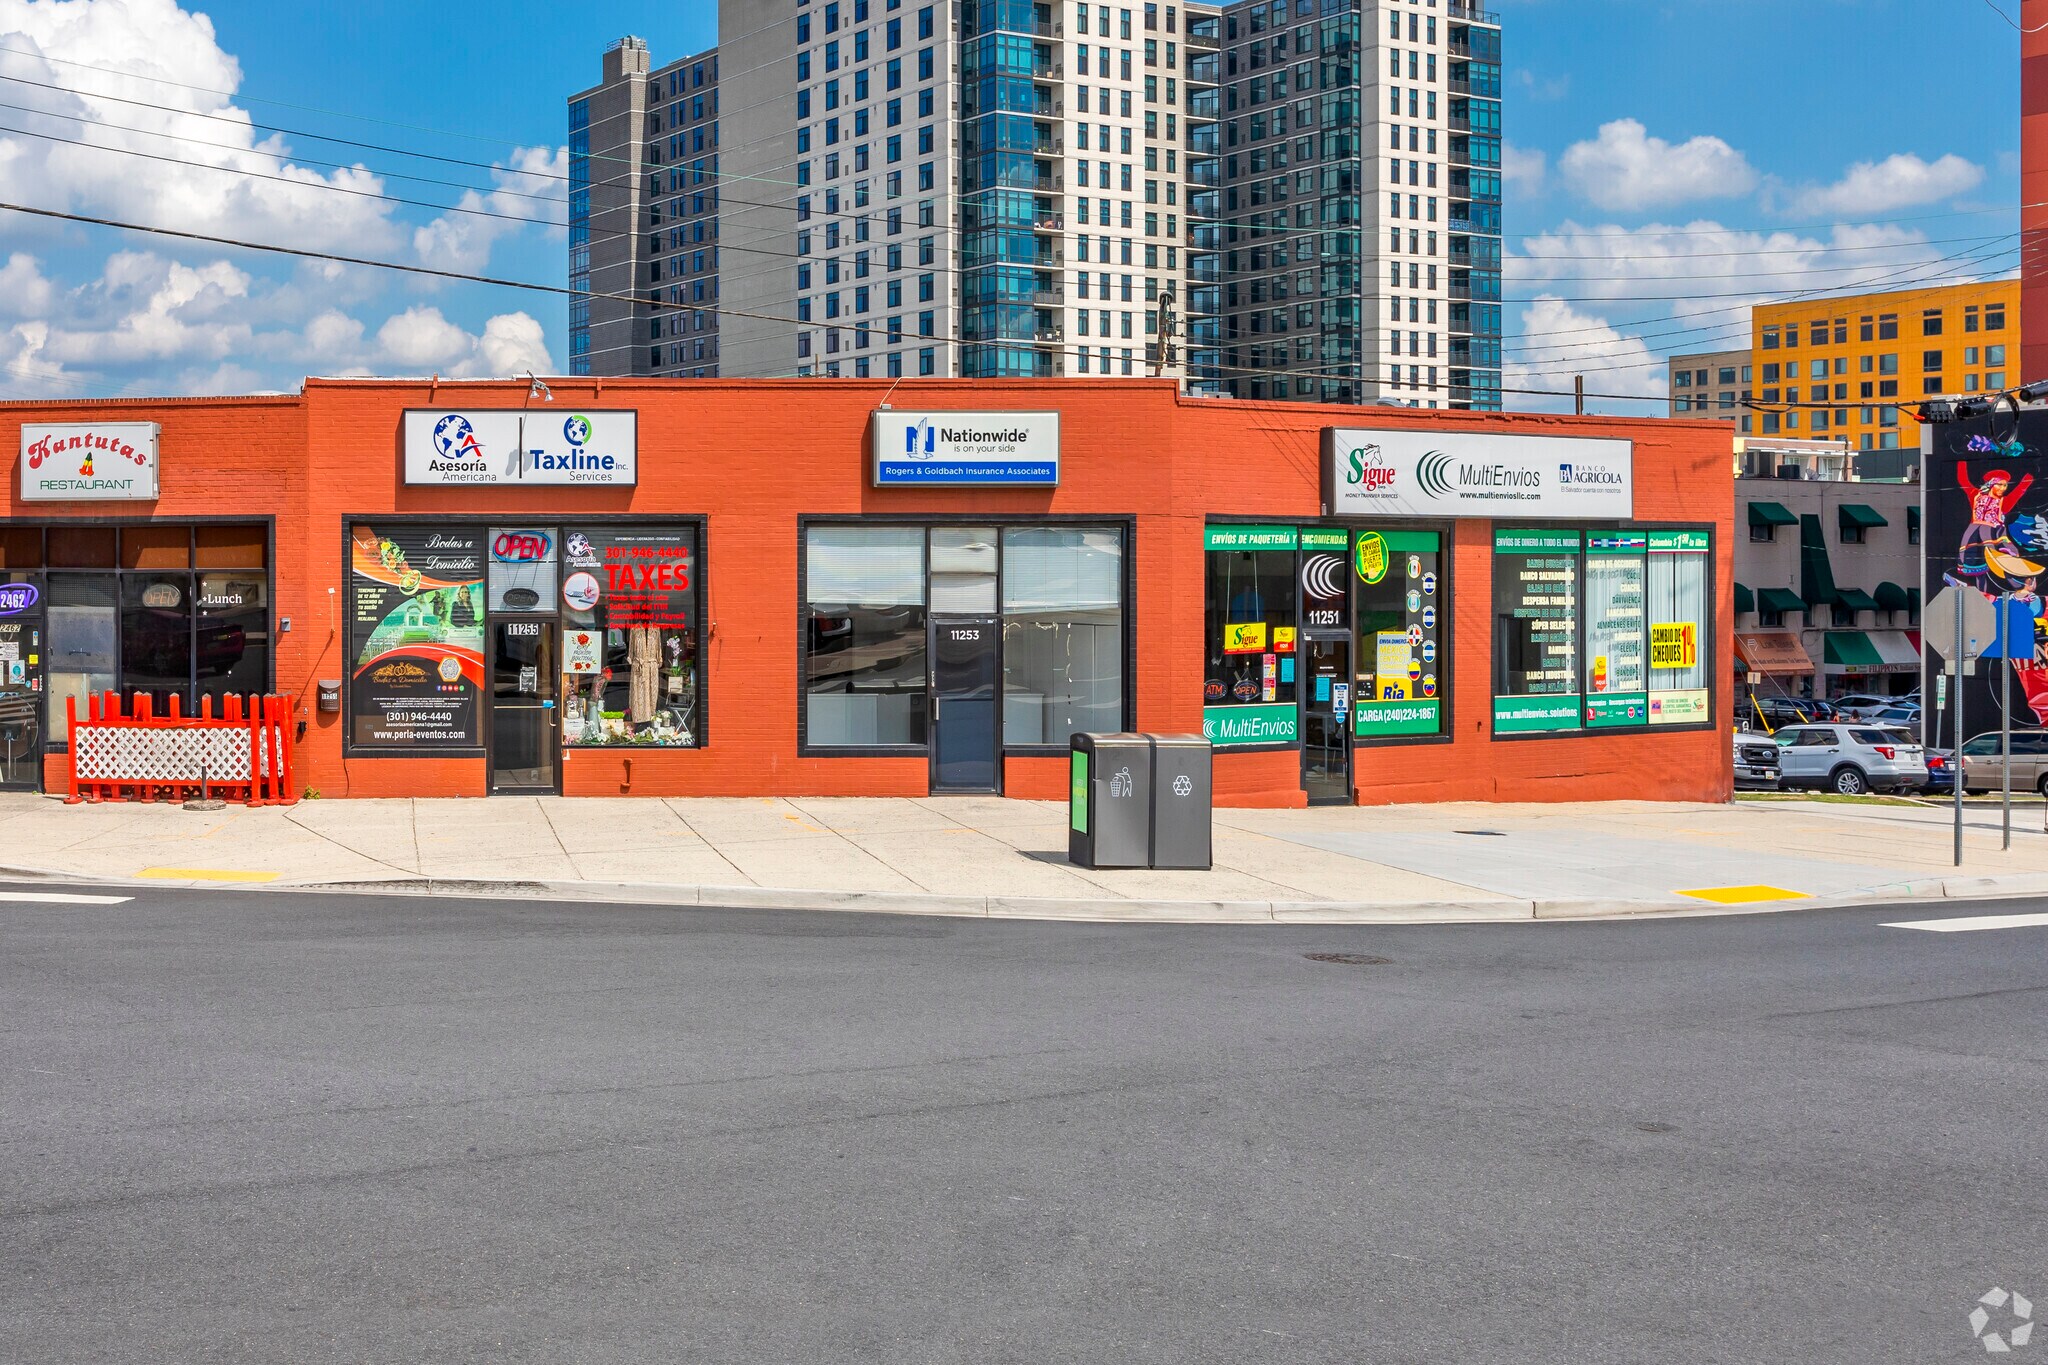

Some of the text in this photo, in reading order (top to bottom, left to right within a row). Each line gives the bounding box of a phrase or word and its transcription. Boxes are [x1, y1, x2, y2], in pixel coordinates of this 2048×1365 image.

[941, 428, 1027, 442] Nationwide
[27, 432, 147, 470] Kantutas
[954, 444, 960, 452] is
[976, 446, 996, 454] your
[998, 444, 1015, 452] side
[530, 449, 628, 470] Taxline Inc.
[429, 459, 487, 472] Asesoría
[1347, 448, 1396, 491] Sigue
[442, 472, 497, 481] Americana
[569, 471, 612, 481] Services
[886, 467, 1050, 476] Rogers & Goldbach Insurance Associates
[1459, 464, 1540, 487] MultiEnvios
[1574, 472, 1622, 483] AGRICOLA
[40, 478, 134, 490] RESTAURANT
[1459, 492, 1541, 500] www.multienviosllc.com
[425, 534, 462, 548] Bodas
[1212, 532, 1347, 544] ENVÍOS DE PAQUETERÍA Y ENCOMIENDAS
[1496, 536, 1579, 547] ENVÍOS DE DINERO A TODO EL MUNDO
[1650, 538, 1672, 547] Colombia
[495, 534, 547, 559] OPEN
[605, 547, 688, 558] 301-946-4440
[425, 555, 475, 570] Domicilio
[1527, 559, 1544, 568] BANCO
[604, 564, 689, 591] TAXES
[1520, 572, 1537, 580] BANCO
[1545, 584, 1552, 593] DE
[0, 594, 25, 608] 2462
[146, 589, 178, 604] OPEN
[207, 594, 242, 604] Lunch
[506, 593, 535, 603] OPEN
[1523, 596, 1575, 605] DESPENSA FAMILIAR
[1309, 610, 1339, 624] 11251
[1514, 609, 1540, 617] DESPENSA
[1542, 609, 1549, 617] DE
[0, 624, 20, 632] 2462
[508, 624, 539, 635] 11255
[1532, 619, 1575, 630] SÚPER SELECTOS
[1597, 621, 1625, 629] ALMACENES
[950, 630, 980, 640] 11253
[1233, 627, 1258, 648] Sigue
[1531, 634, 1548, 642] BANCO
[1653, 625, 1695, 664] CAMBIO DE 1%
[1653, 645, 1681, 663] CHEQUES
[1543, 658, 1560, 667] BANCO
[1526, 671, 1544, 680] BANCO
[1206, 685, 1223, 694] ATM
[1236, 686, 1257, 695] OPEN
[1383, 683, 1404, 699] Ria
[1529, 683, 1546, 692] BANCO
[386, 712, 452, 721] (301) 946-4440
[1358, 709, 1384, 722] CARGA
[1220, 717, 1295, 737] MultiEnvios
[374, 730, 465, 741] www.perla-eventos.com
